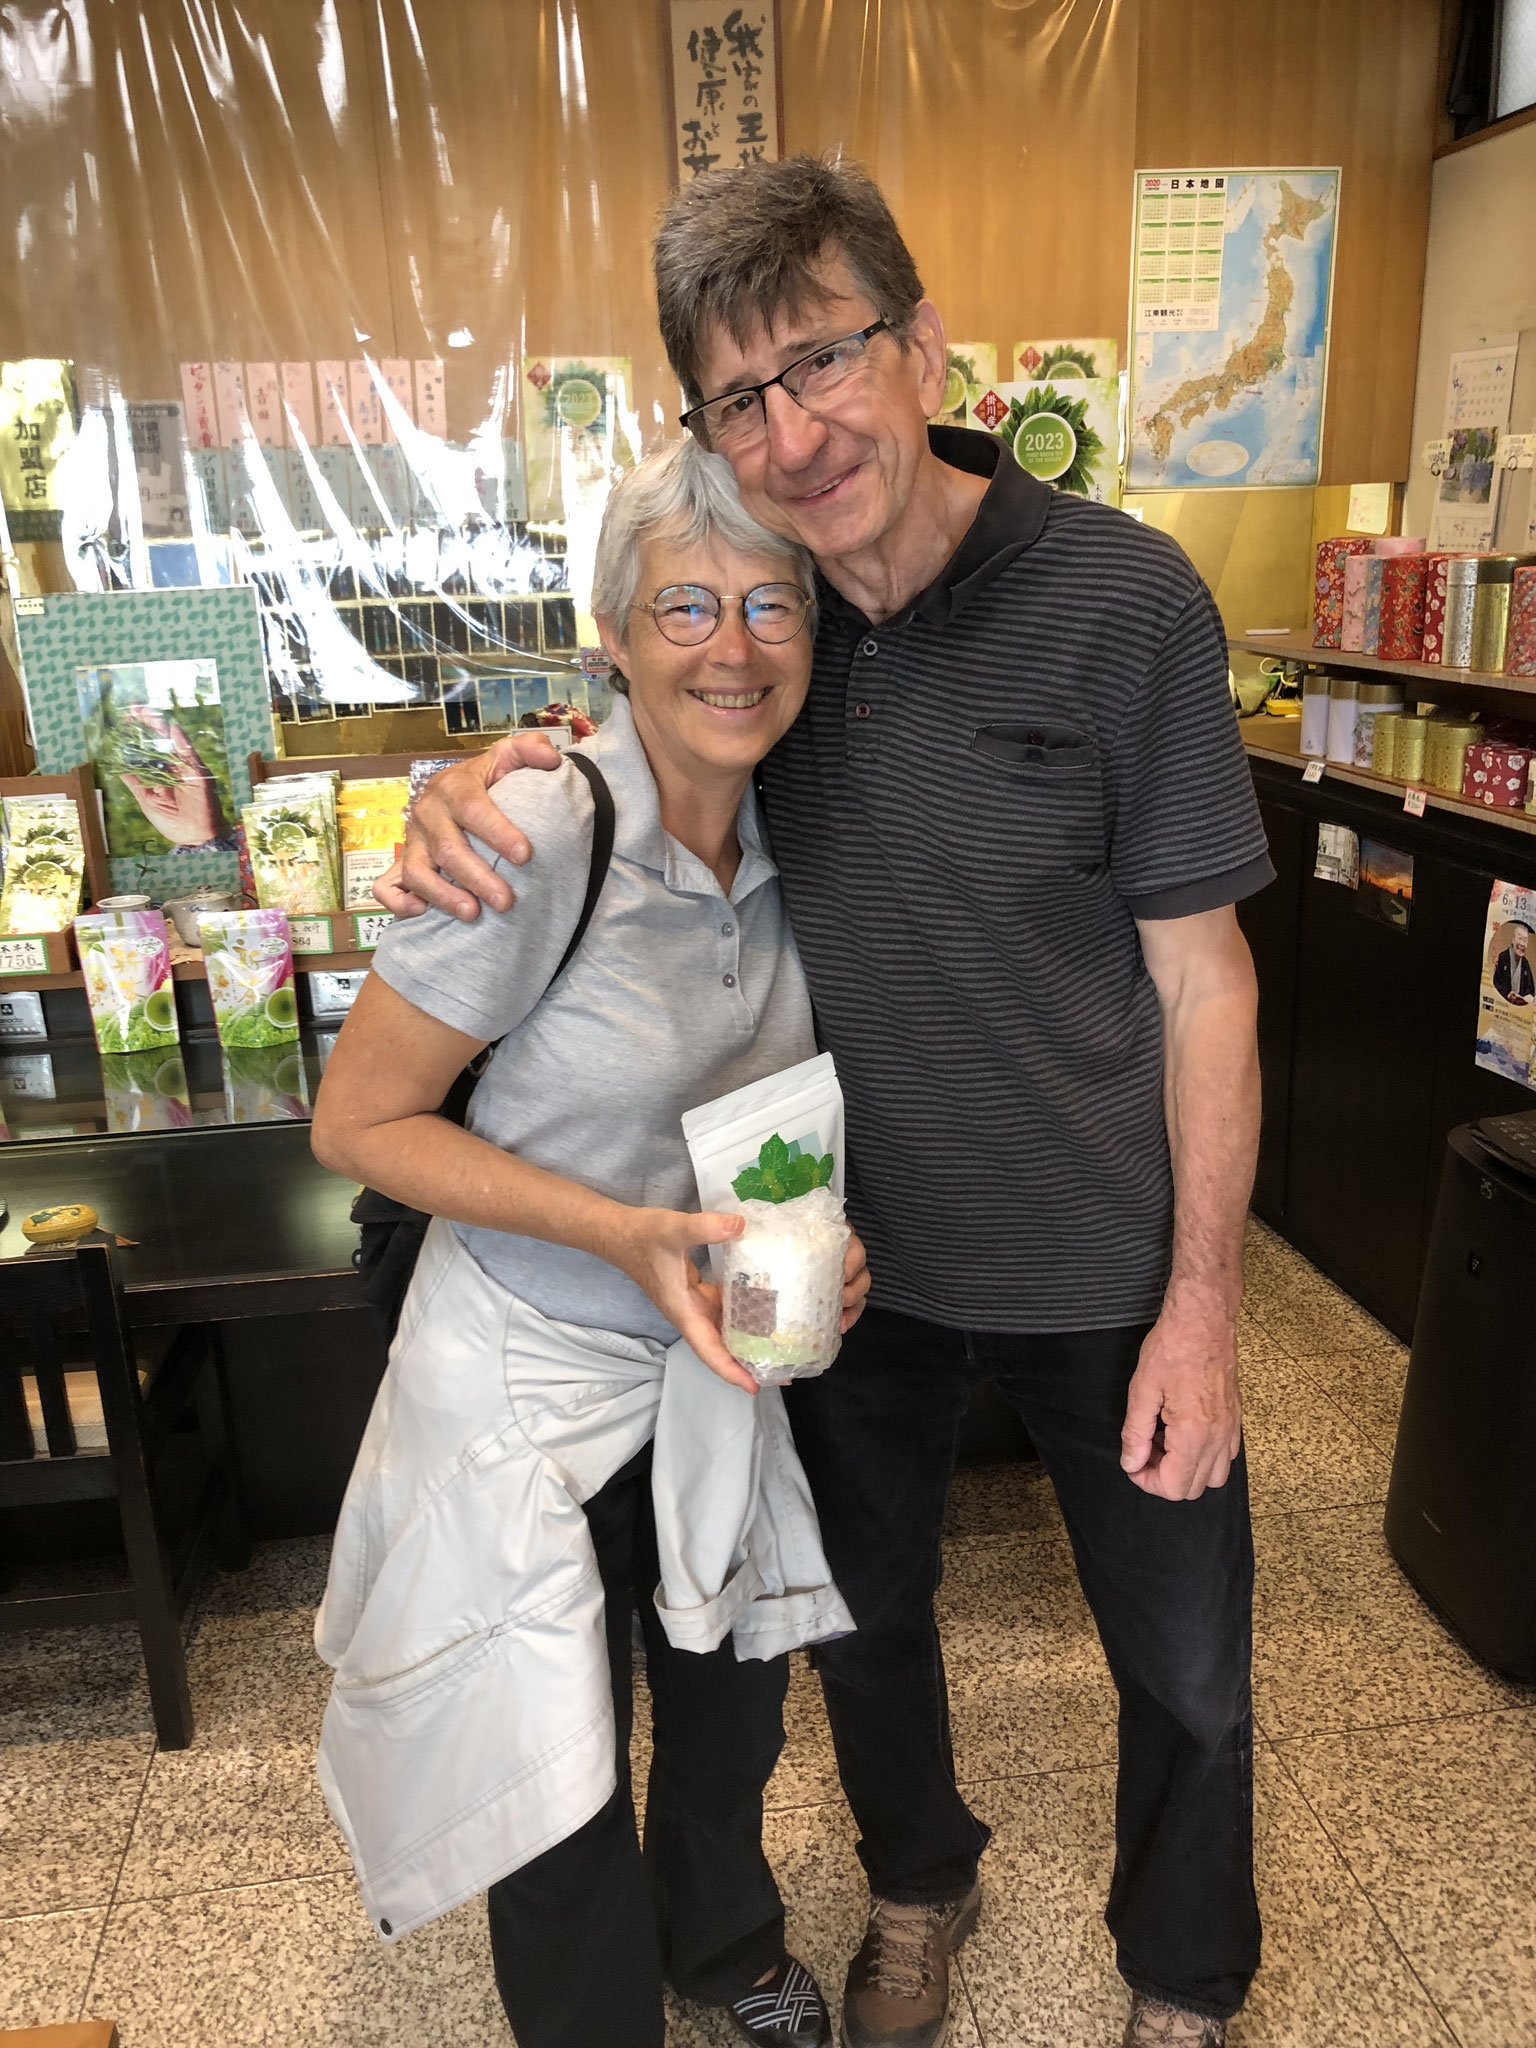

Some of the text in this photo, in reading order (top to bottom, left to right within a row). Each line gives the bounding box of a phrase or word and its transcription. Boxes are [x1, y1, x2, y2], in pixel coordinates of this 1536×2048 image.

[1145, 179, 1161, 187] 2020
[1170, 178, 1224, 190] 日本地図
[985, 394, 998, 427] 掛川産
[1025, 432, 1065, 451] 2023
[15, 418, 48, 499] 加盟店
